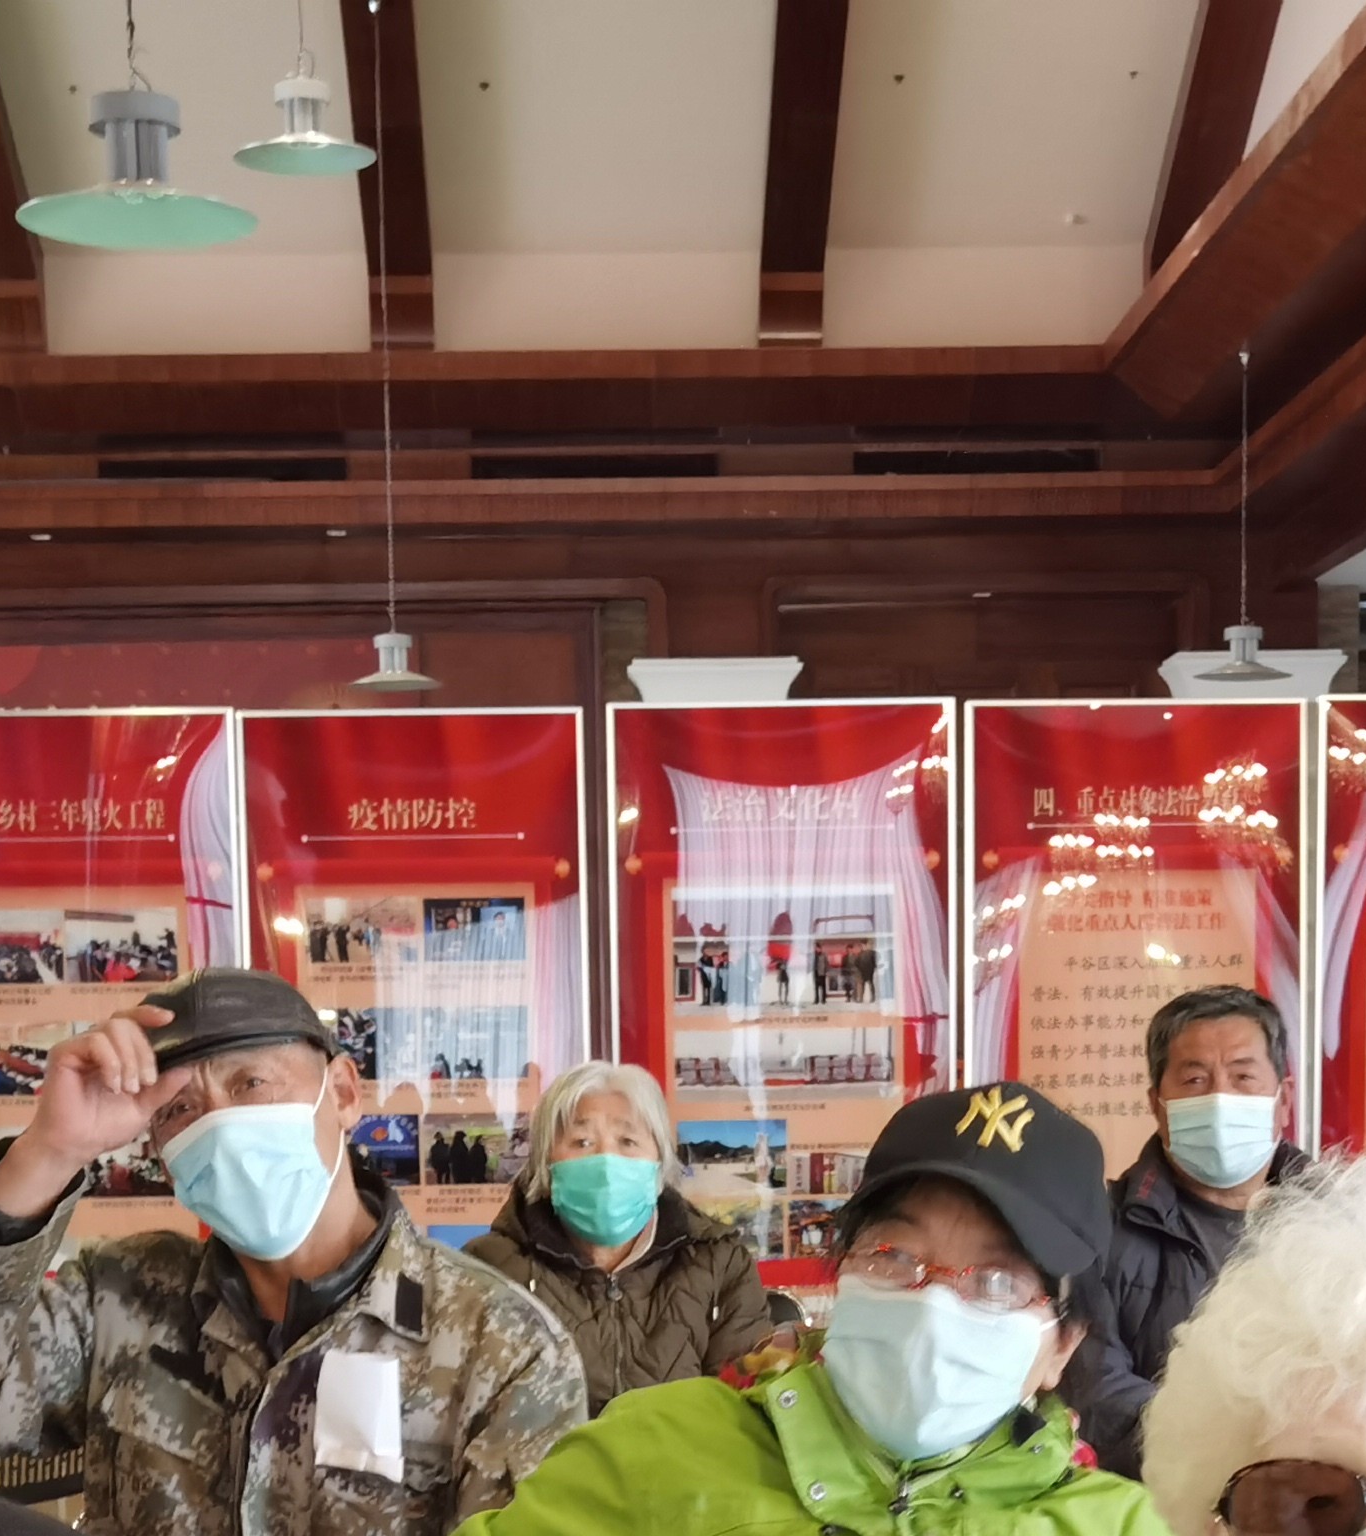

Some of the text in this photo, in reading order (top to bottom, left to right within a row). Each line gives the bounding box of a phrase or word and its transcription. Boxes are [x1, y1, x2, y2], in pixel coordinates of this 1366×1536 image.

[347, 797, 477, 831] 疫情防控
[954, 1085, 1035, 1153] NY
